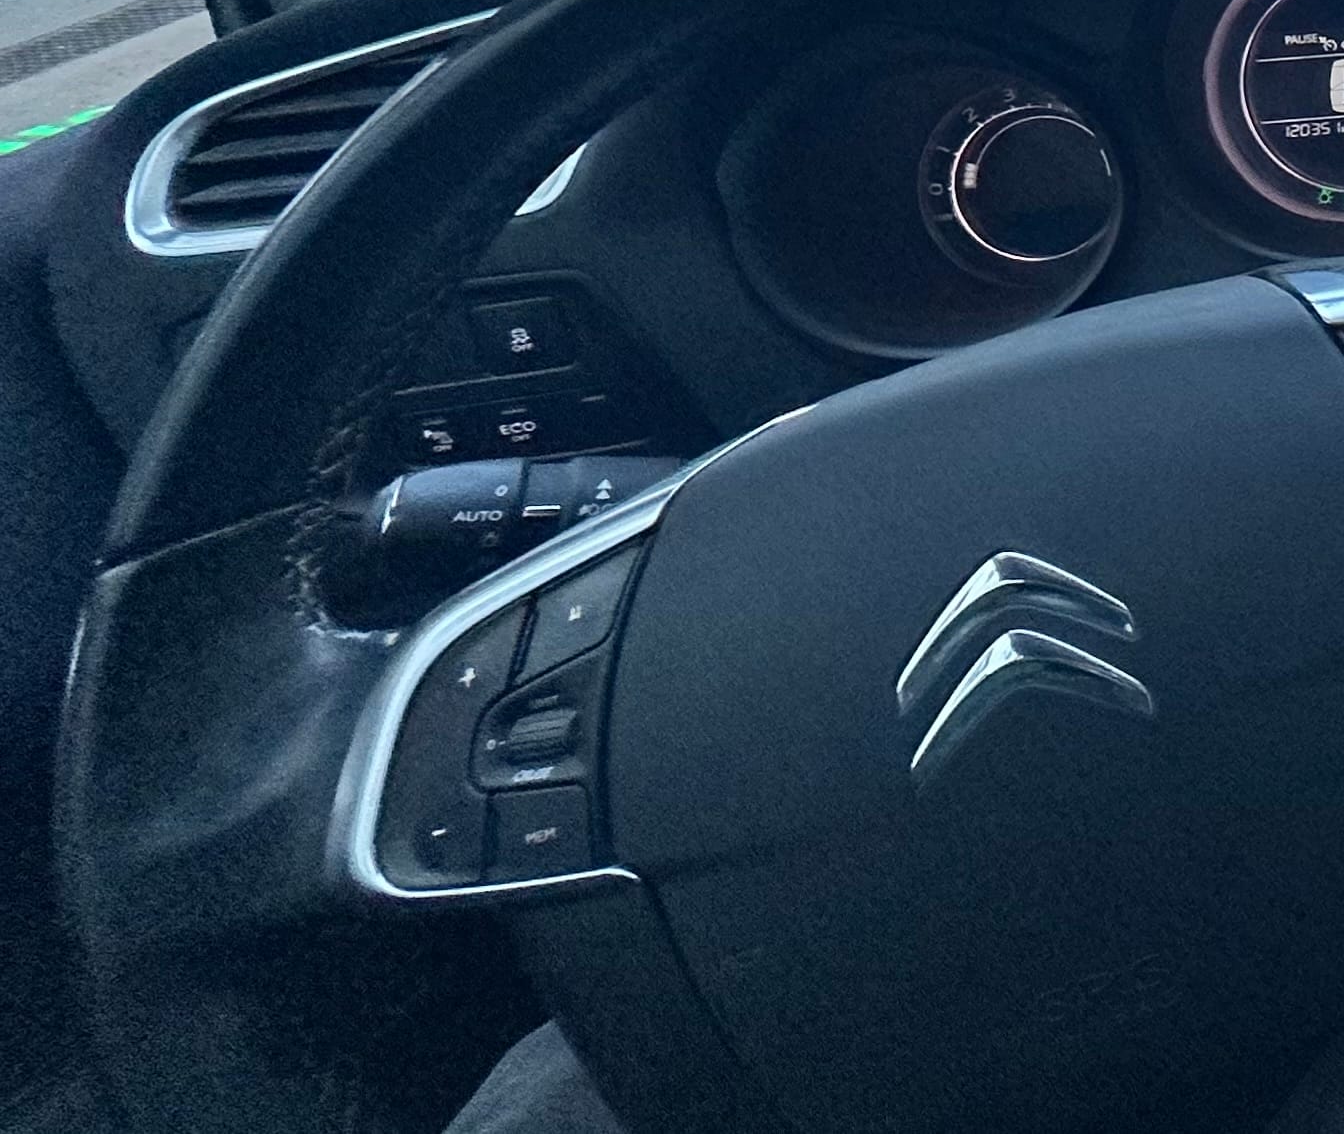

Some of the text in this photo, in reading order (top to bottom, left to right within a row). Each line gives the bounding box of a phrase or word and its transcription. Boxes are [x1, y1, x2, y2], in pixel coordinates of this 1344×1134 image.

[1284, 33, 1319, 45] PAUSE
[499, 420, 537, 436] ECO
[452, 510, 503, 523] AUTO
